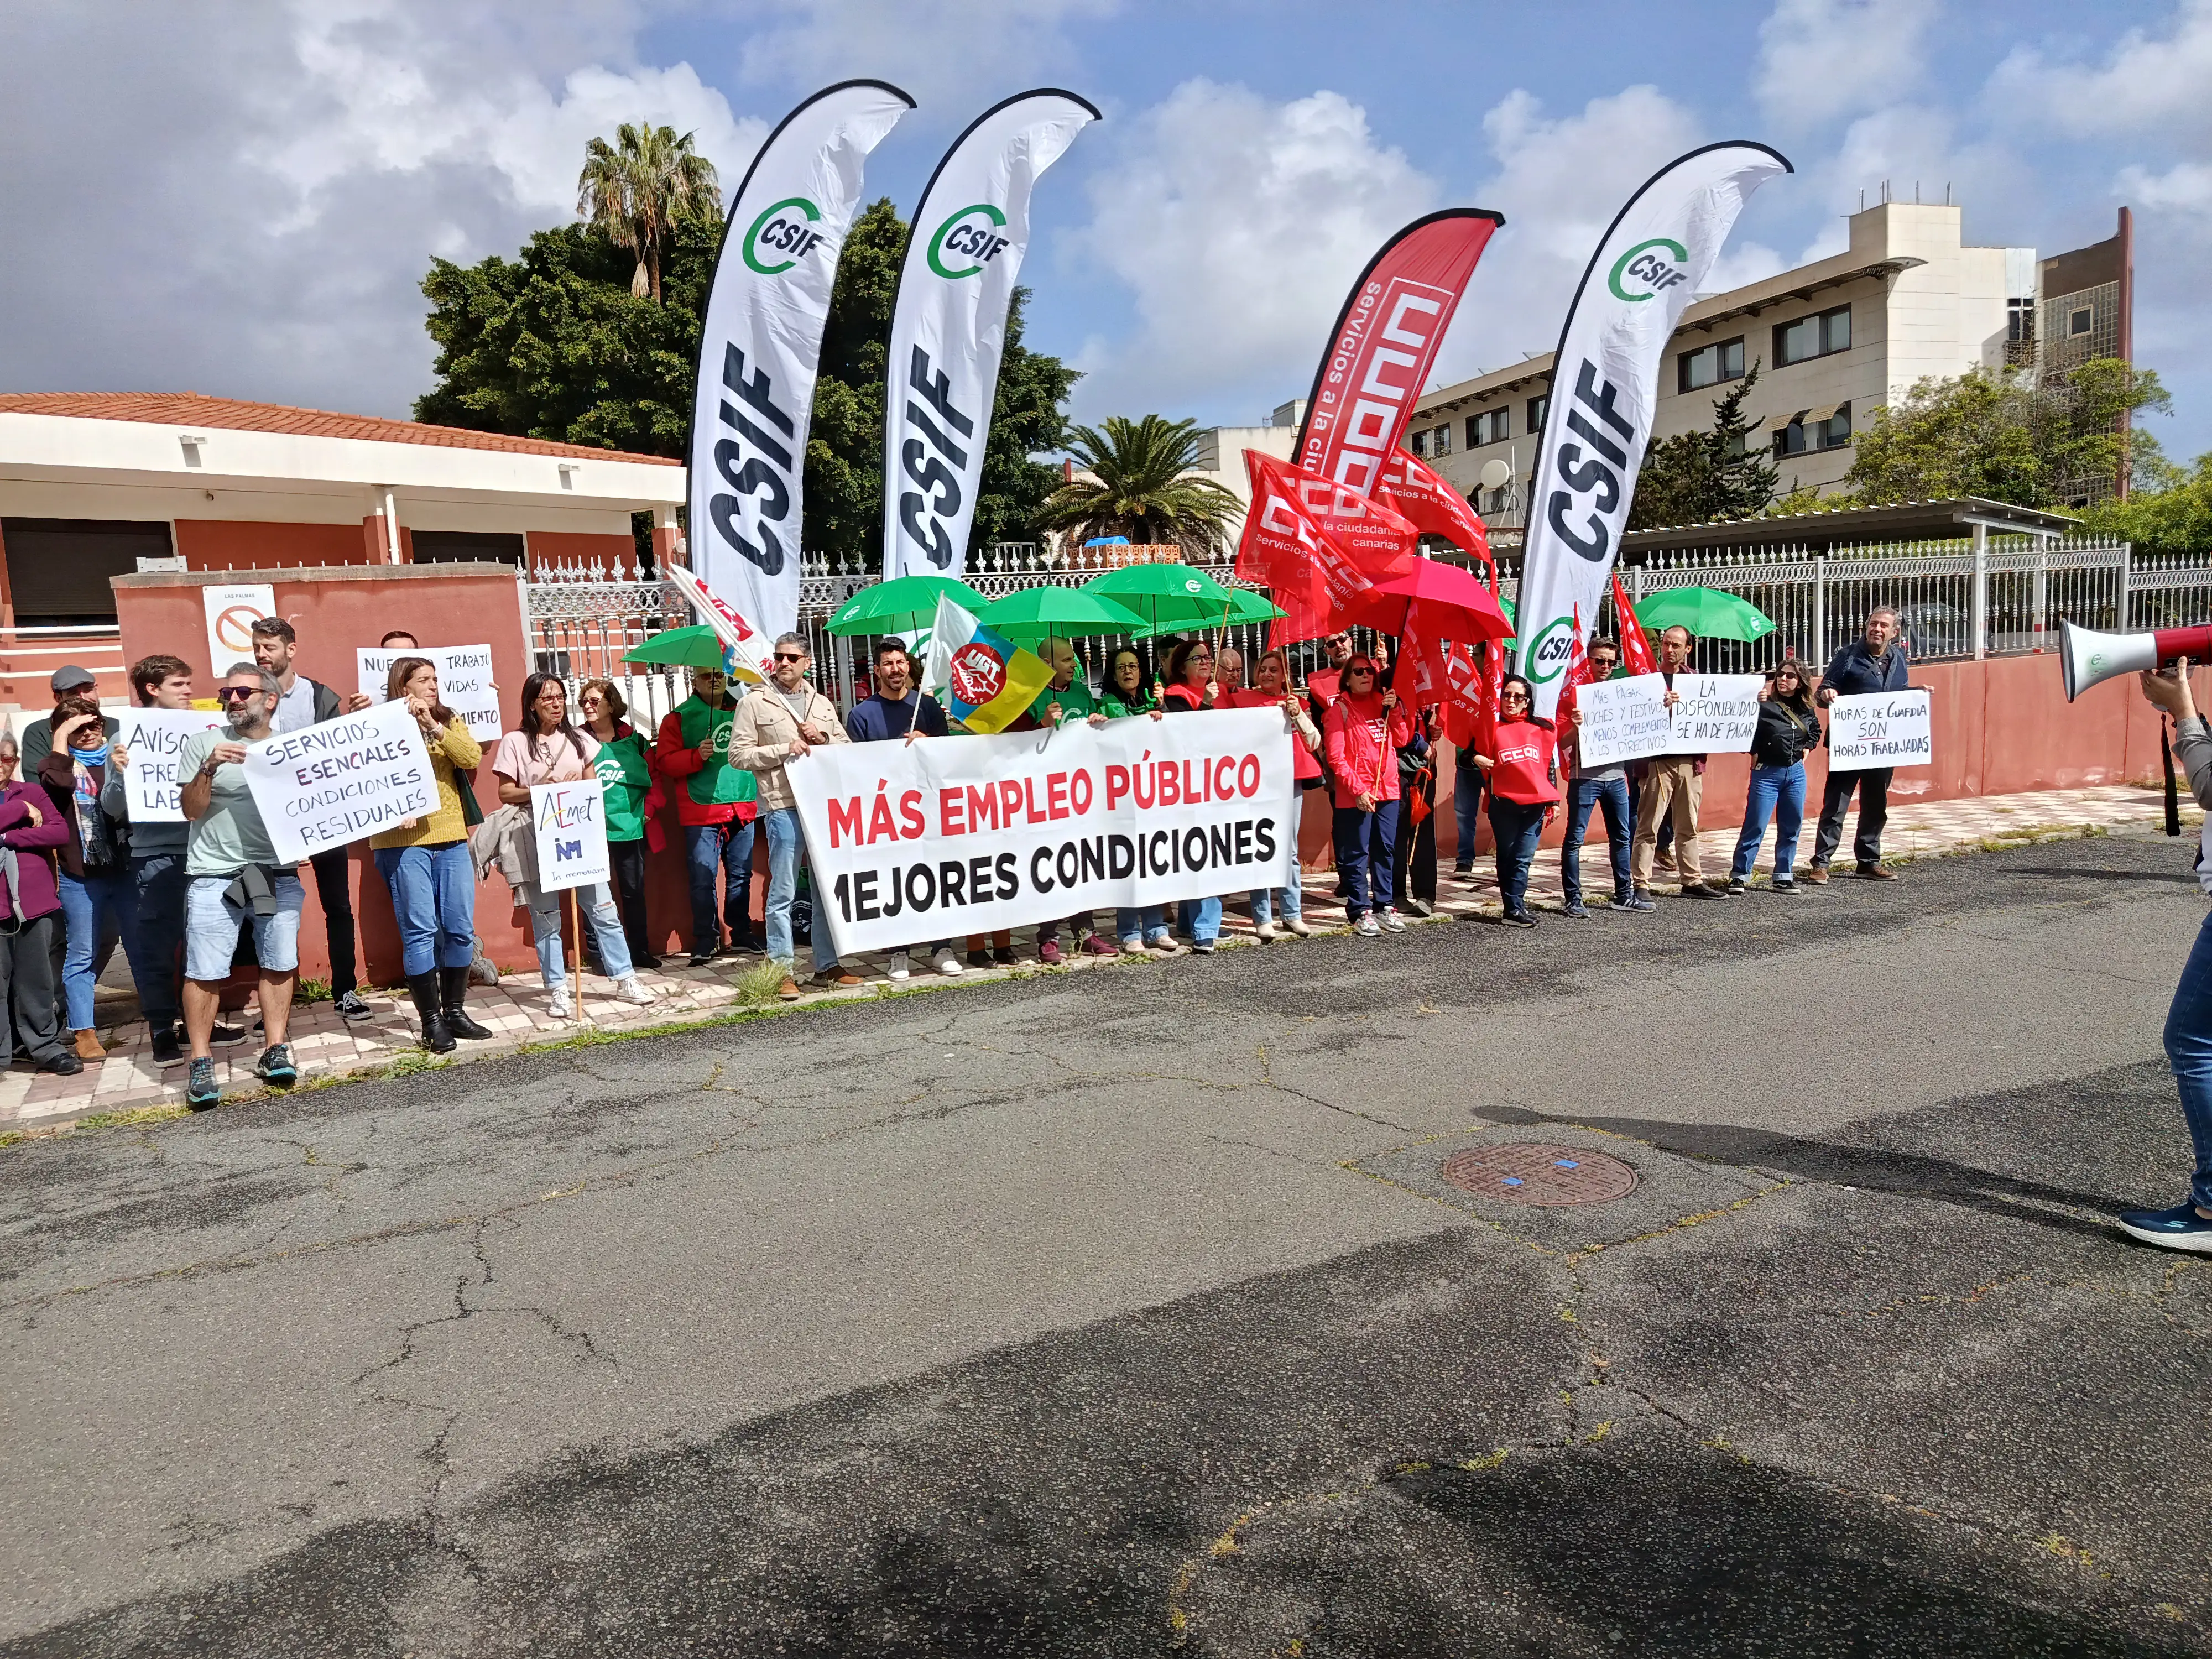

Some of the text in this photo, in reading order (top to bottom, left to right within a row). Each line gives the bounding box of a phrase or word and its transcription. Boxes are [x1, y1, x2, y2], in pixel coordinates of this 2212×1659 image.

[760, 218, 824, 258] CSIF
[945, 224, 1010, 262] CSIF
[1627, 254, 1687, 291] CSIF
[1329, 281, 1381, 384] servicios
[1321, 390, 1336, 404] a
[1313, 411, 1334, 430] la
[710, 340, 795, 576] CSIF
[899, 343, 974, 571] CSIF
[1548, 357, 1635, 563] CSIF
[1337, 523, 1401, 536] ciudadan
[1256, 534, 1307, 559] servicios
[1353, 539, 1400, 550] canarias
[446, 653, 490, 669] TRABAJO
[965, 649, 1001, 681] UGT
[444, 679, 479, 692] VIDAS
[1616, 685, 1643, 700] PAGAR
[1700, 680, 1715, 697] LA
[1584, 708, 1614, 727] NOCHES
[1620, 706, 1625, 720] Y
[1676, 700, 1759, 717] DISPONIBILIDAD
[1834, 707, 1867, 721] HORAS
[1872, 708, 1884, 718] DE
[1583, 718, 1669, 744] Y MENOS COMPLEMENTOS
[1677, 722, 1691, 738] SE
[1858, 721, 1887, 738] SON
[265, 720, 379, 765] SERVICIOS
[1589, 747, 1594, 758] A
[1598, 745, 1609, 756] LOS
[1834, 735, 1929, 757] HORAS TRABAJADAS
[296, 739, 410, 786] ESENCIALES
[1500, 747, 1538, 762] CCOO
[140, 764, 176, 783] PRE
[597, 769, 626, 781] CSIF
[144, 790, 181, 810] LAB
[286, 768, 421, 817] CONDICIONES
[827, 749, 1261, 848] MÁS EMPLEO PÚBLICO
[300, 789, 427, 846] RESIDUALES
[1030, 818, 1275, 894] CONDICIONES
[552, 867, 606, 881] In memoriam
